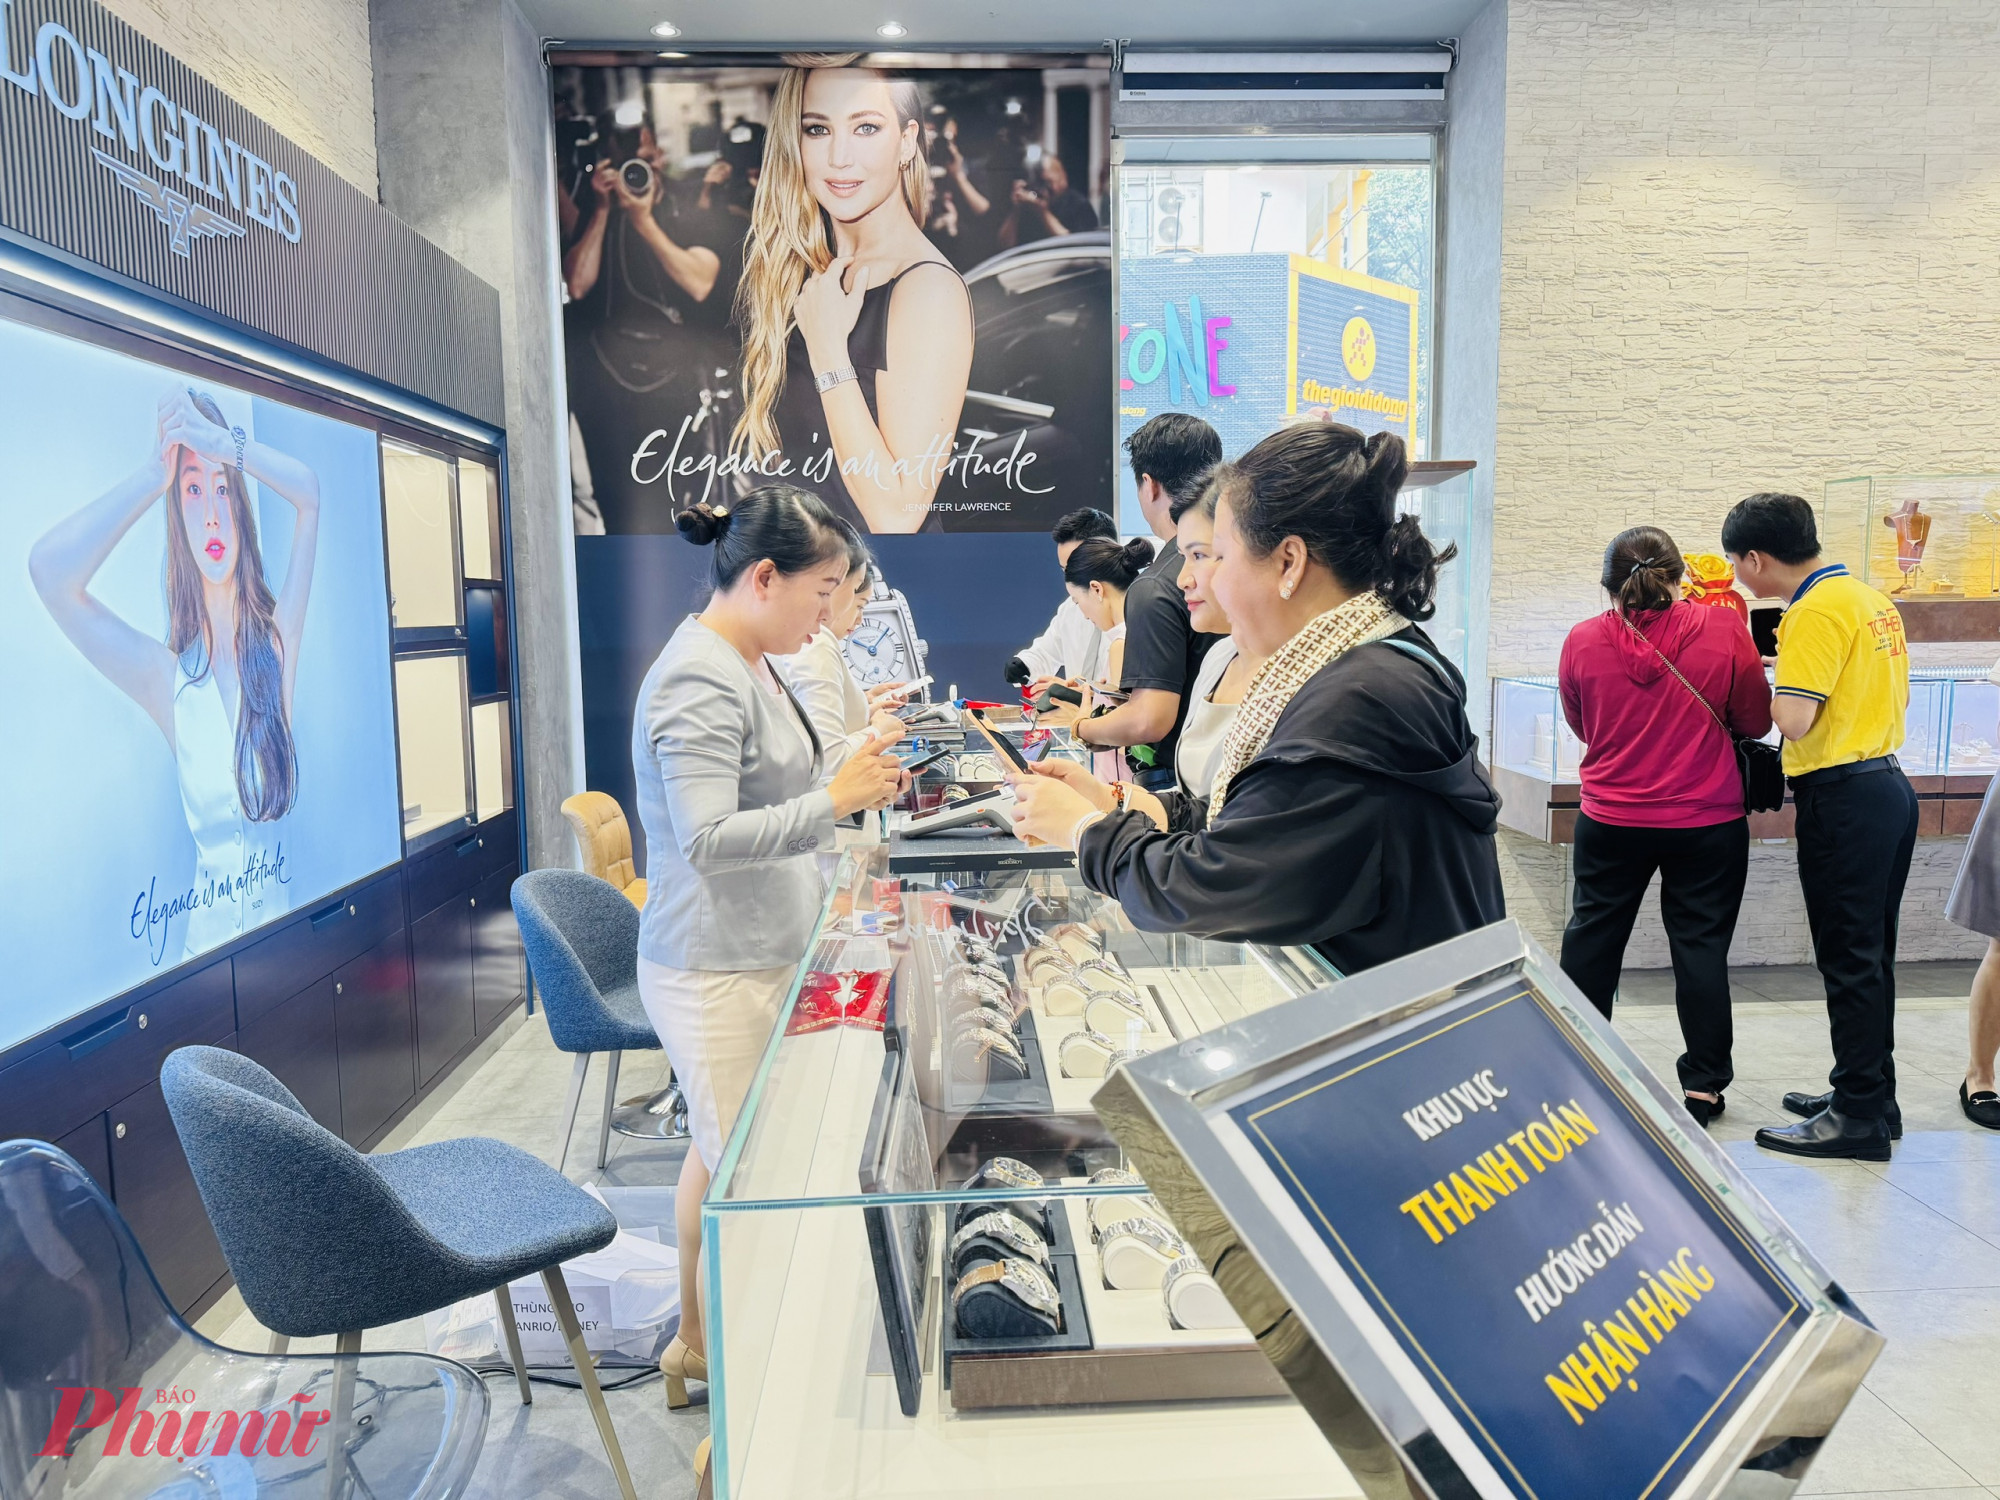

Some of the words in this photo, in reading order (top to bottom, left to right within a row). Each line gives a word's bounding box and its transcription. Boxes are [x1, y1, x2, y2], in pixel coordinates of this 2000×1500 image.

[0, 0, 301, 244] LONGINES
[1303, 379, 1408, 422] thegioididong
[630, 415, 796, 524] Elegance
[802, 433, 834, 483] is
[842, 448, 890, 490] an
[892, 429, 1056, 494] attitude
[902, 503, 953, 512] JENNIFER
[954, 502, 1012, 511] LAWRENCE
[131, 876, 200, 966] Elegance
[203, 870, 215, 908] is
[217, 874, 237, 903] an
[236, 841, 292, 897] attitude
[1403, 1088, 1462, 1141] KHU
[1456, 1069, 1508, 1112] VỰC
[1400, 1144, 1531, 1244] THANH
[1507, 1099, 1600, 1174] TOÁN
[1515, 1249, 1606, 1323] HƯỚNG
[1592, 1201, 1645, 1258] DẪN
[1544, 1309, 1651, 1426] NHẬN
[1626, 1246, 1715, 1344] HÀNG
